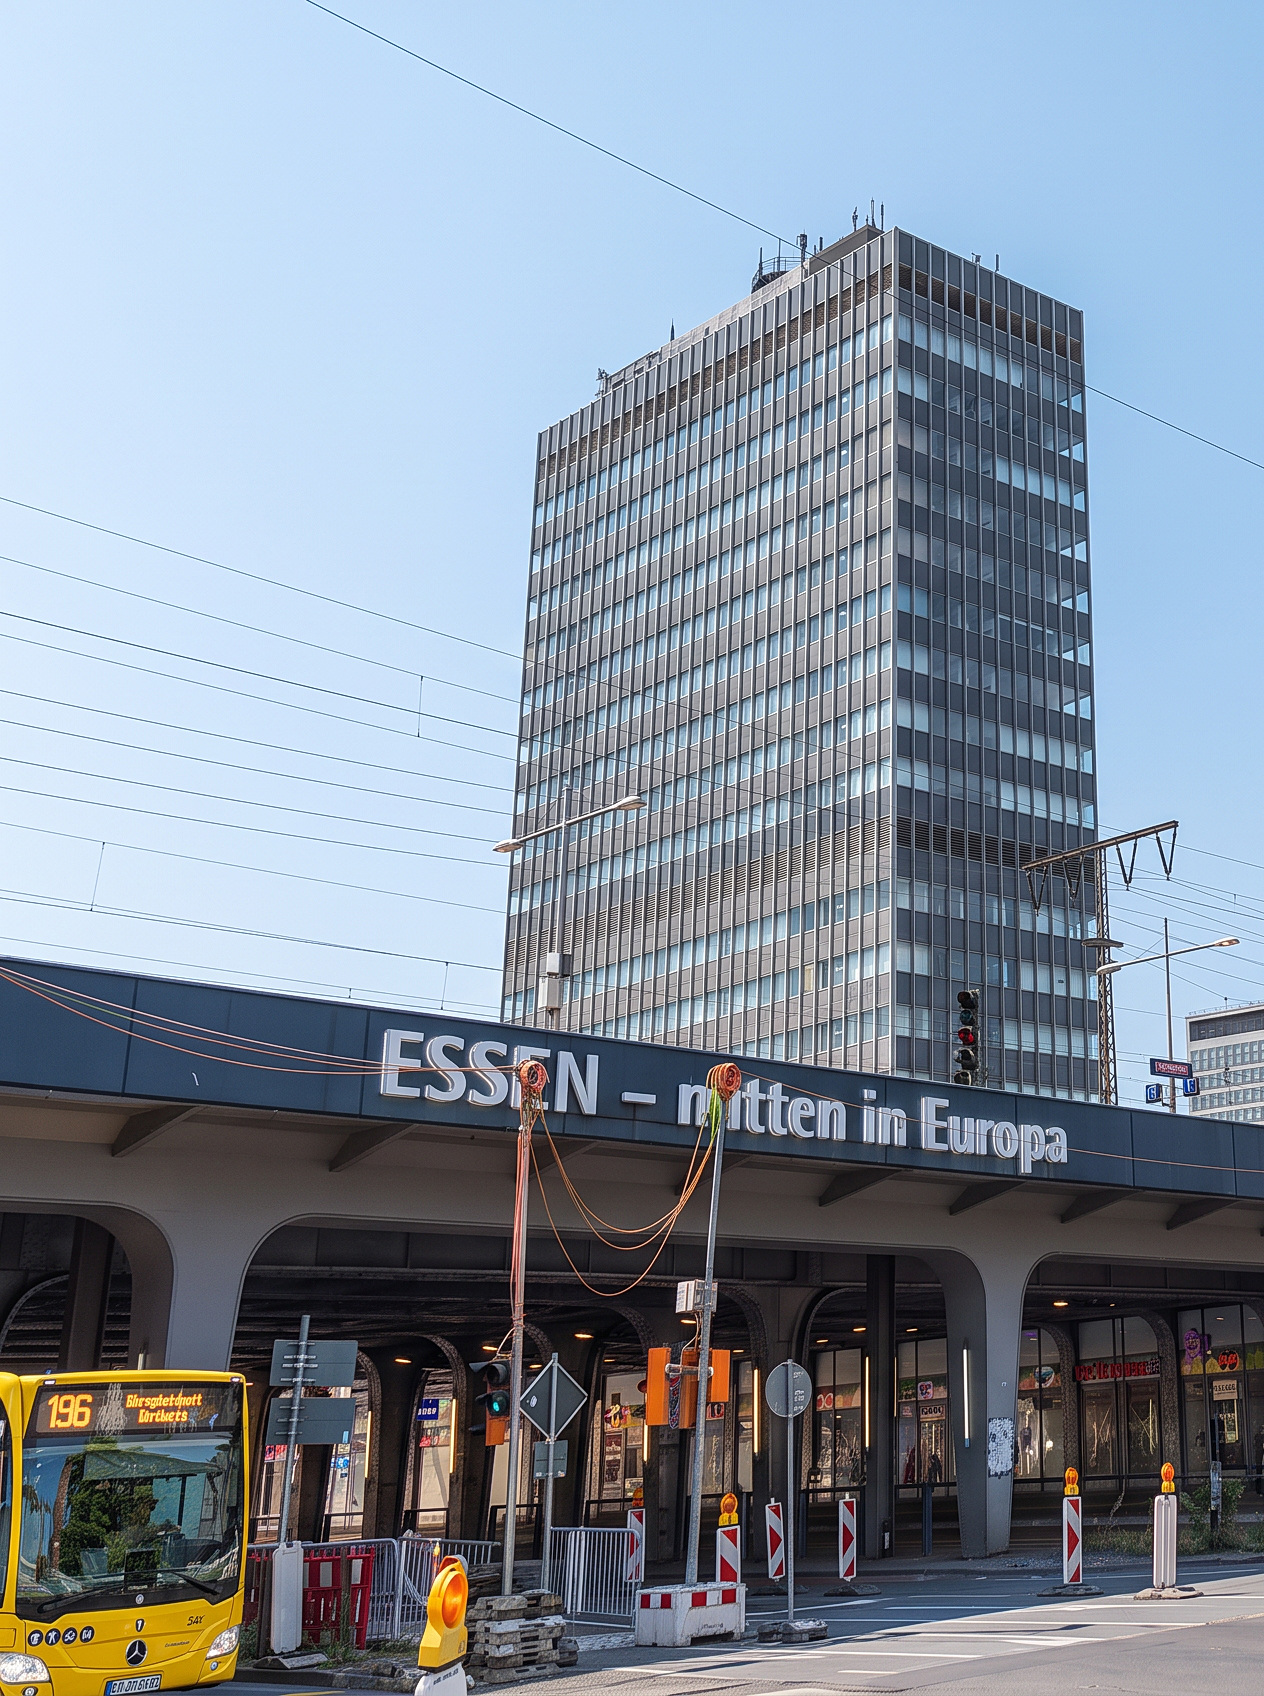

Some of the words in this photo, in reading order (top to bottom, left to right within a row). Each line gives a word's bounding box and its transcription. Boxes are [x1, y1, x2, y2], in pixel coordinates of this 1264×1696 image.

[380, 1028, 600, 1116] ESSEN
[677, 1077, 847, 1142] mitten
[862, 1088, 907, 1147] in
[920, 1096, 1068, 1174] Europa
[48, 1394, 93, 1429] 196
